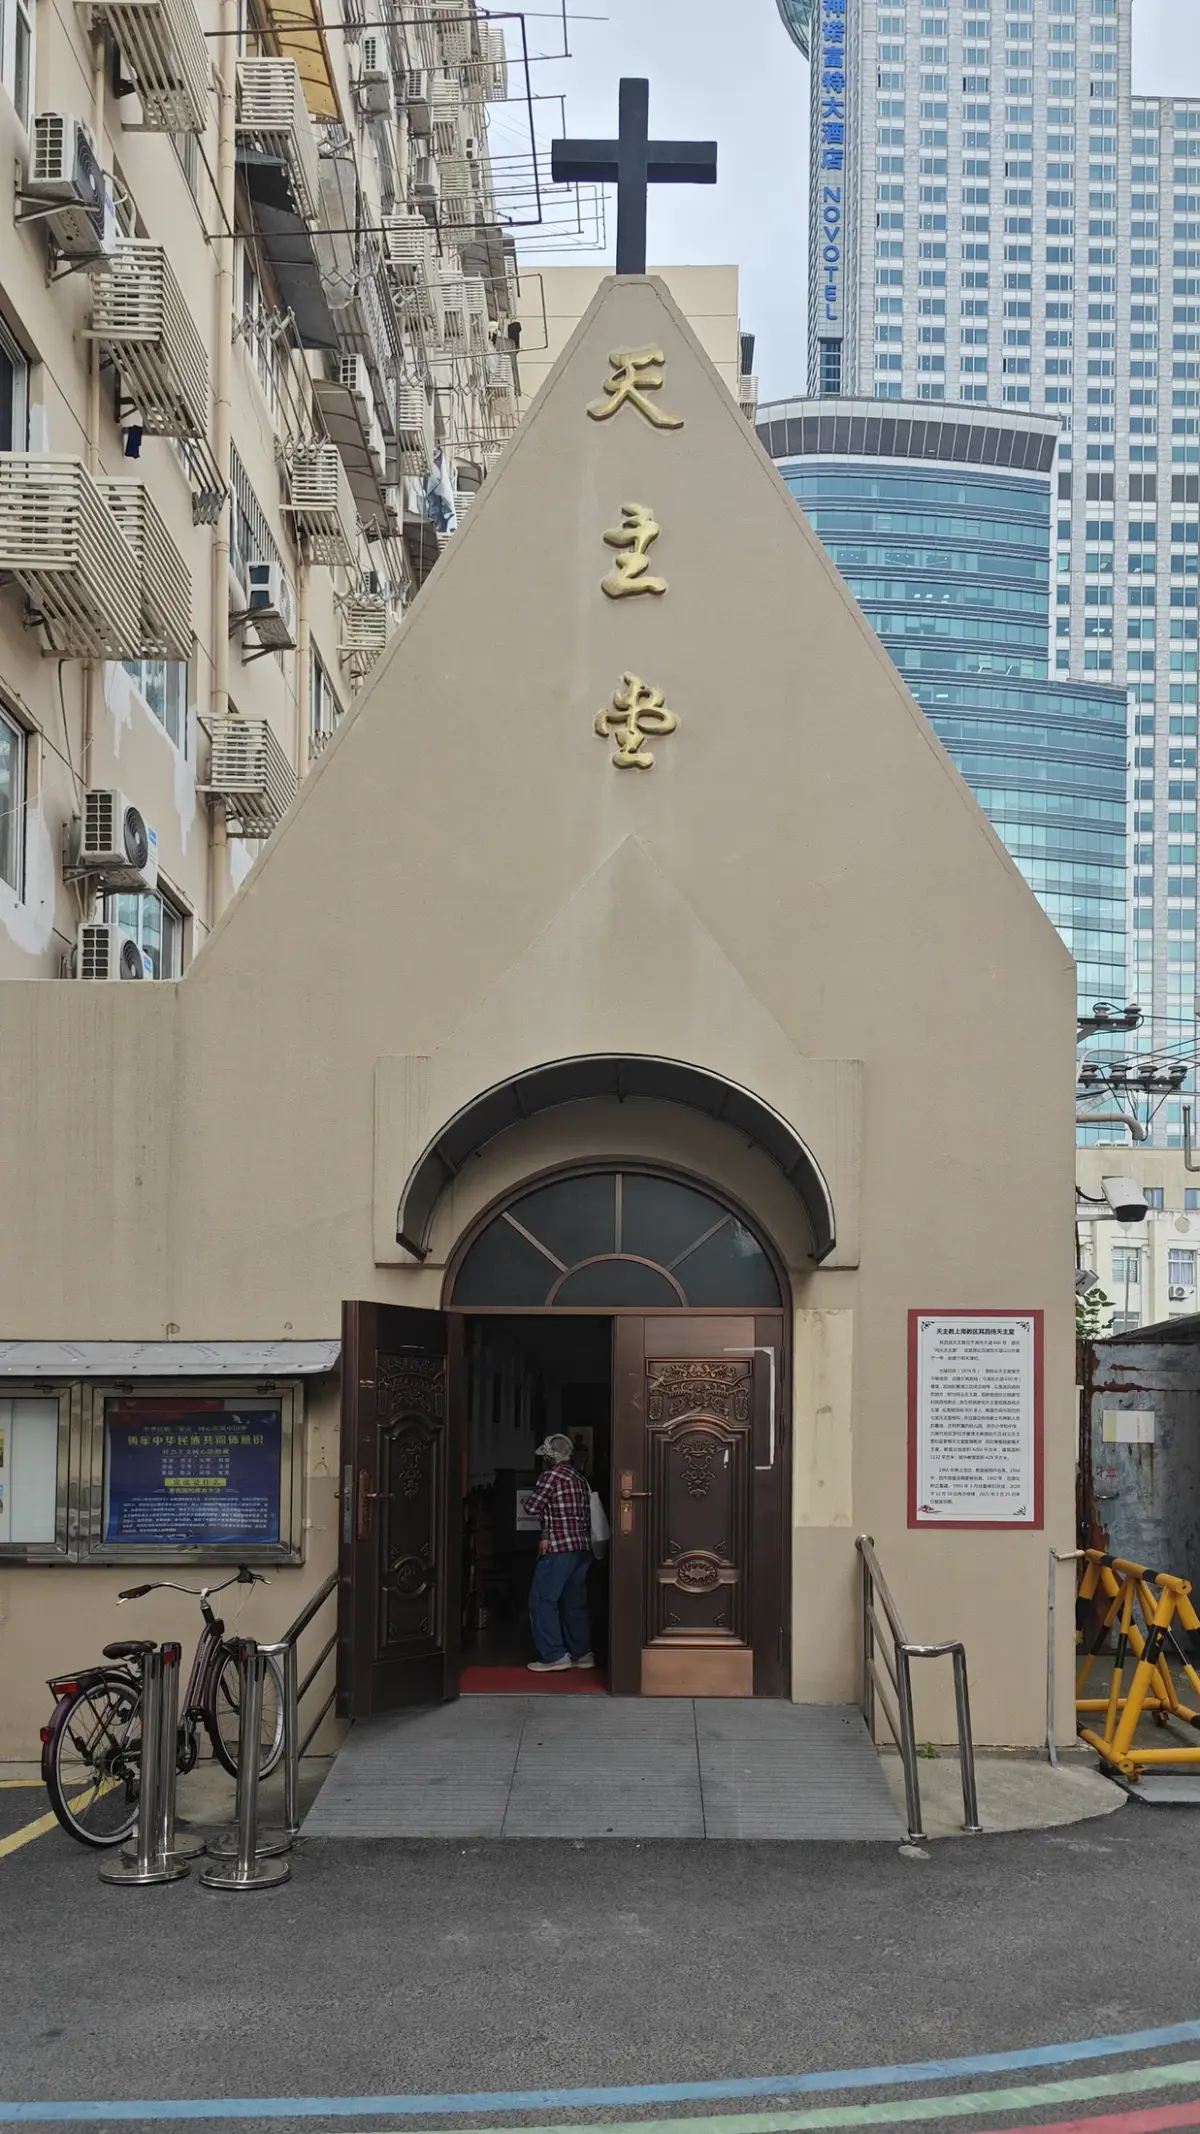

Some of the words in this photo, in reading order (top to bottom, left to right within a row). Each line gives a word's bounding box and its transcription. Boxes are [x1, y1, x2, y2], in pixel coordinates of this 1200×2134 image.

[822, 186, 841, 321] NOVOTEL
[587, 346, 684, 770] 天主堂
